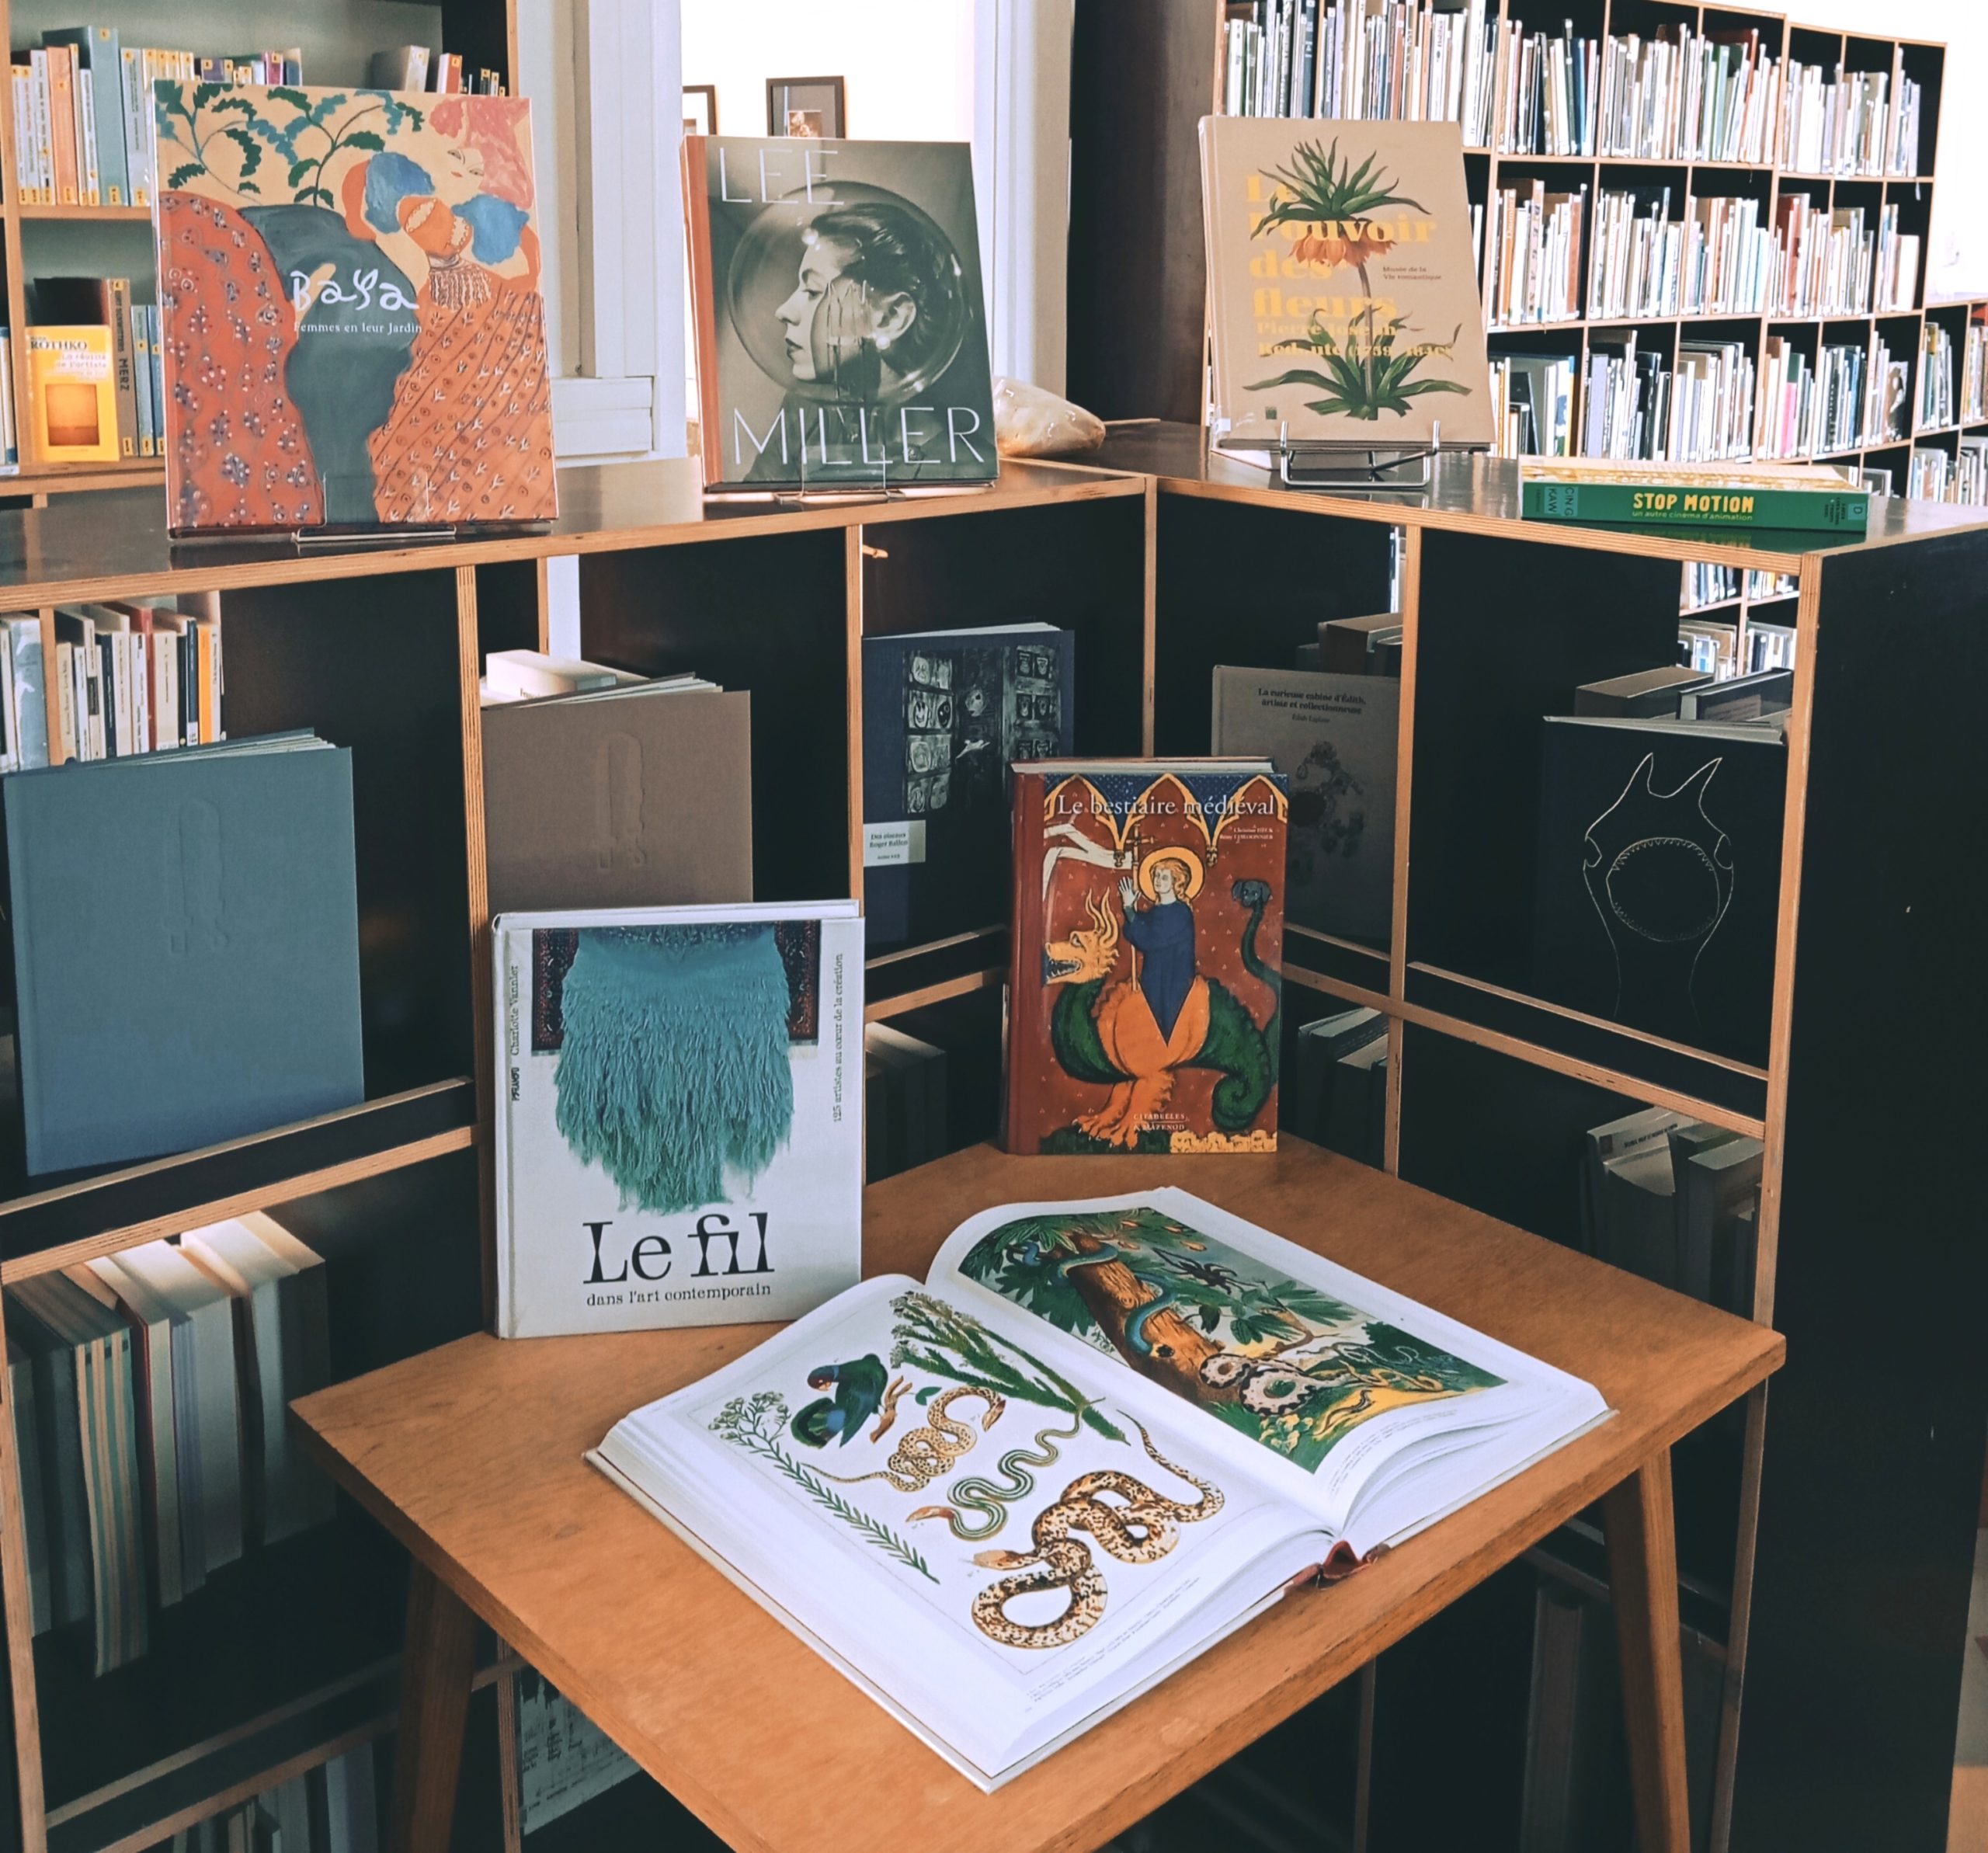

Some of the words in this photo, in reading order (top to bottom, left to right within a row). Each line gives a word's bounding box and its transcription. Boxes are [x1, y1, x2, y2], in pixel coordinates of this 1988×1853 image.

[720, 148, 844, 205] LEE
[1250, 249, 1334, 279] des
[1253, 287, 1397, 319] fleurs
[294, 322, 340, 332] Femmes
[362, 322, 385, 332] leur
[388, 322, 422, 335] Jardin
[119, 358, 130, 391] MERZ
[734, 408, 985, 464] MILLER
[1548, 488, 1558, 513] KAW
[1633, 492, 1678, 510] STOP
[1684, 494, 1754, 513] MOTION
[1289, 700, 1298, 709] et
[1058, 794, 1083, 815] Le
[1090, 794, 1176, 815] bestiaire
[1183, 794, 1275, 815] médiéval
[833, 953, 843, 996] création
[834, 996, 843, 1006] la
[834, 1008, 843, 1021] de
[510, 1007, 520, 1056] Charlotte
[835, 1051, 843, 1064] au
[834, 1066, 843, 1104] artistes
[833, 1104, 842, 1122] 125
[582, 1221, 672, 1284] Le
[687, 1212, 775, 1278] fil
[586, 1293, 624, 1307] dans
[629, 1290, 660, 1304] l'art
[664, 1282, 772, 1302] contemporain
